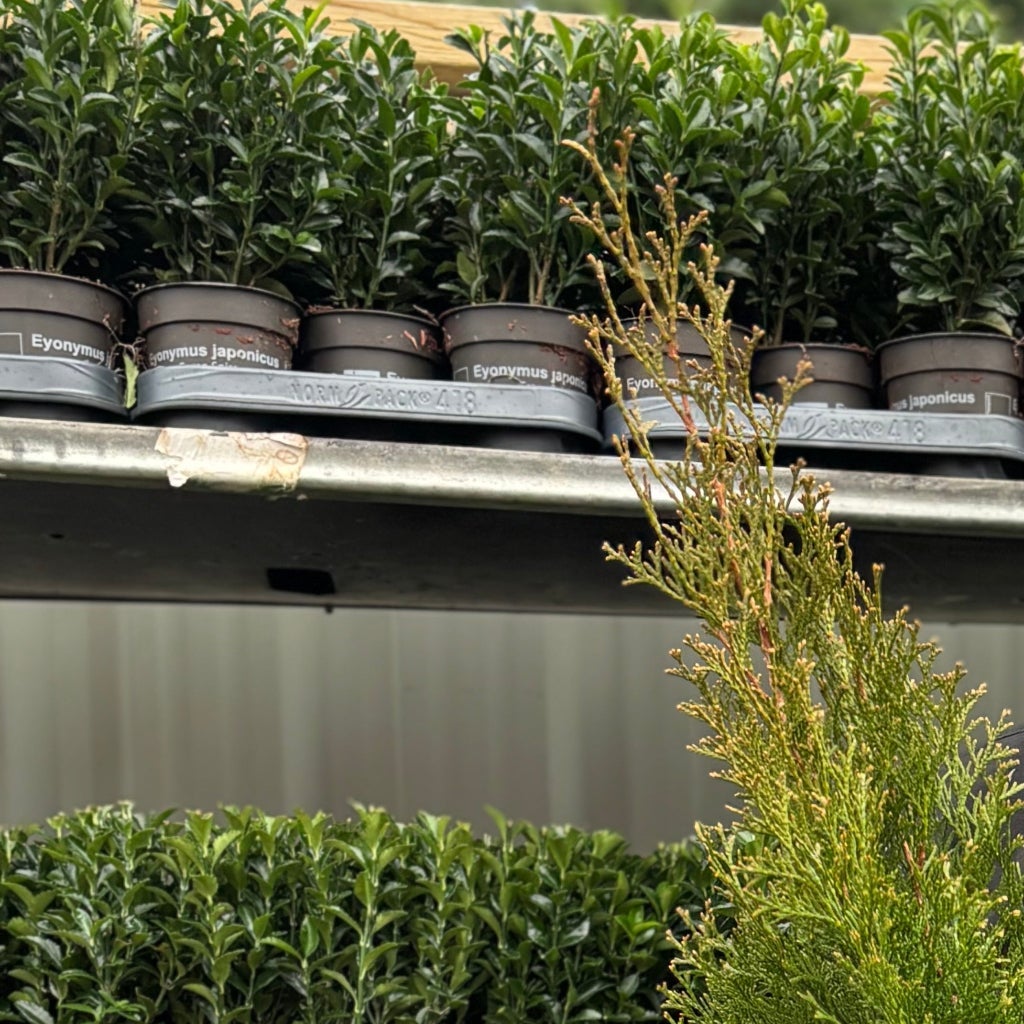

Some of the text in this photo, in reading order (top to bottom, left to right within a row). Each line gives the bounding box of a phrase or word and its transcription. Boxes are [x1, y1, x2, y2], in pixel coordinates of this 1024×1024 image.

[31, 333, 105, 361] Eyonymus
[211, 344, 280, 368] japonicus
[473, 364, 548, 379] Eyonymus
[909, 390, 975, 410] japonicus
